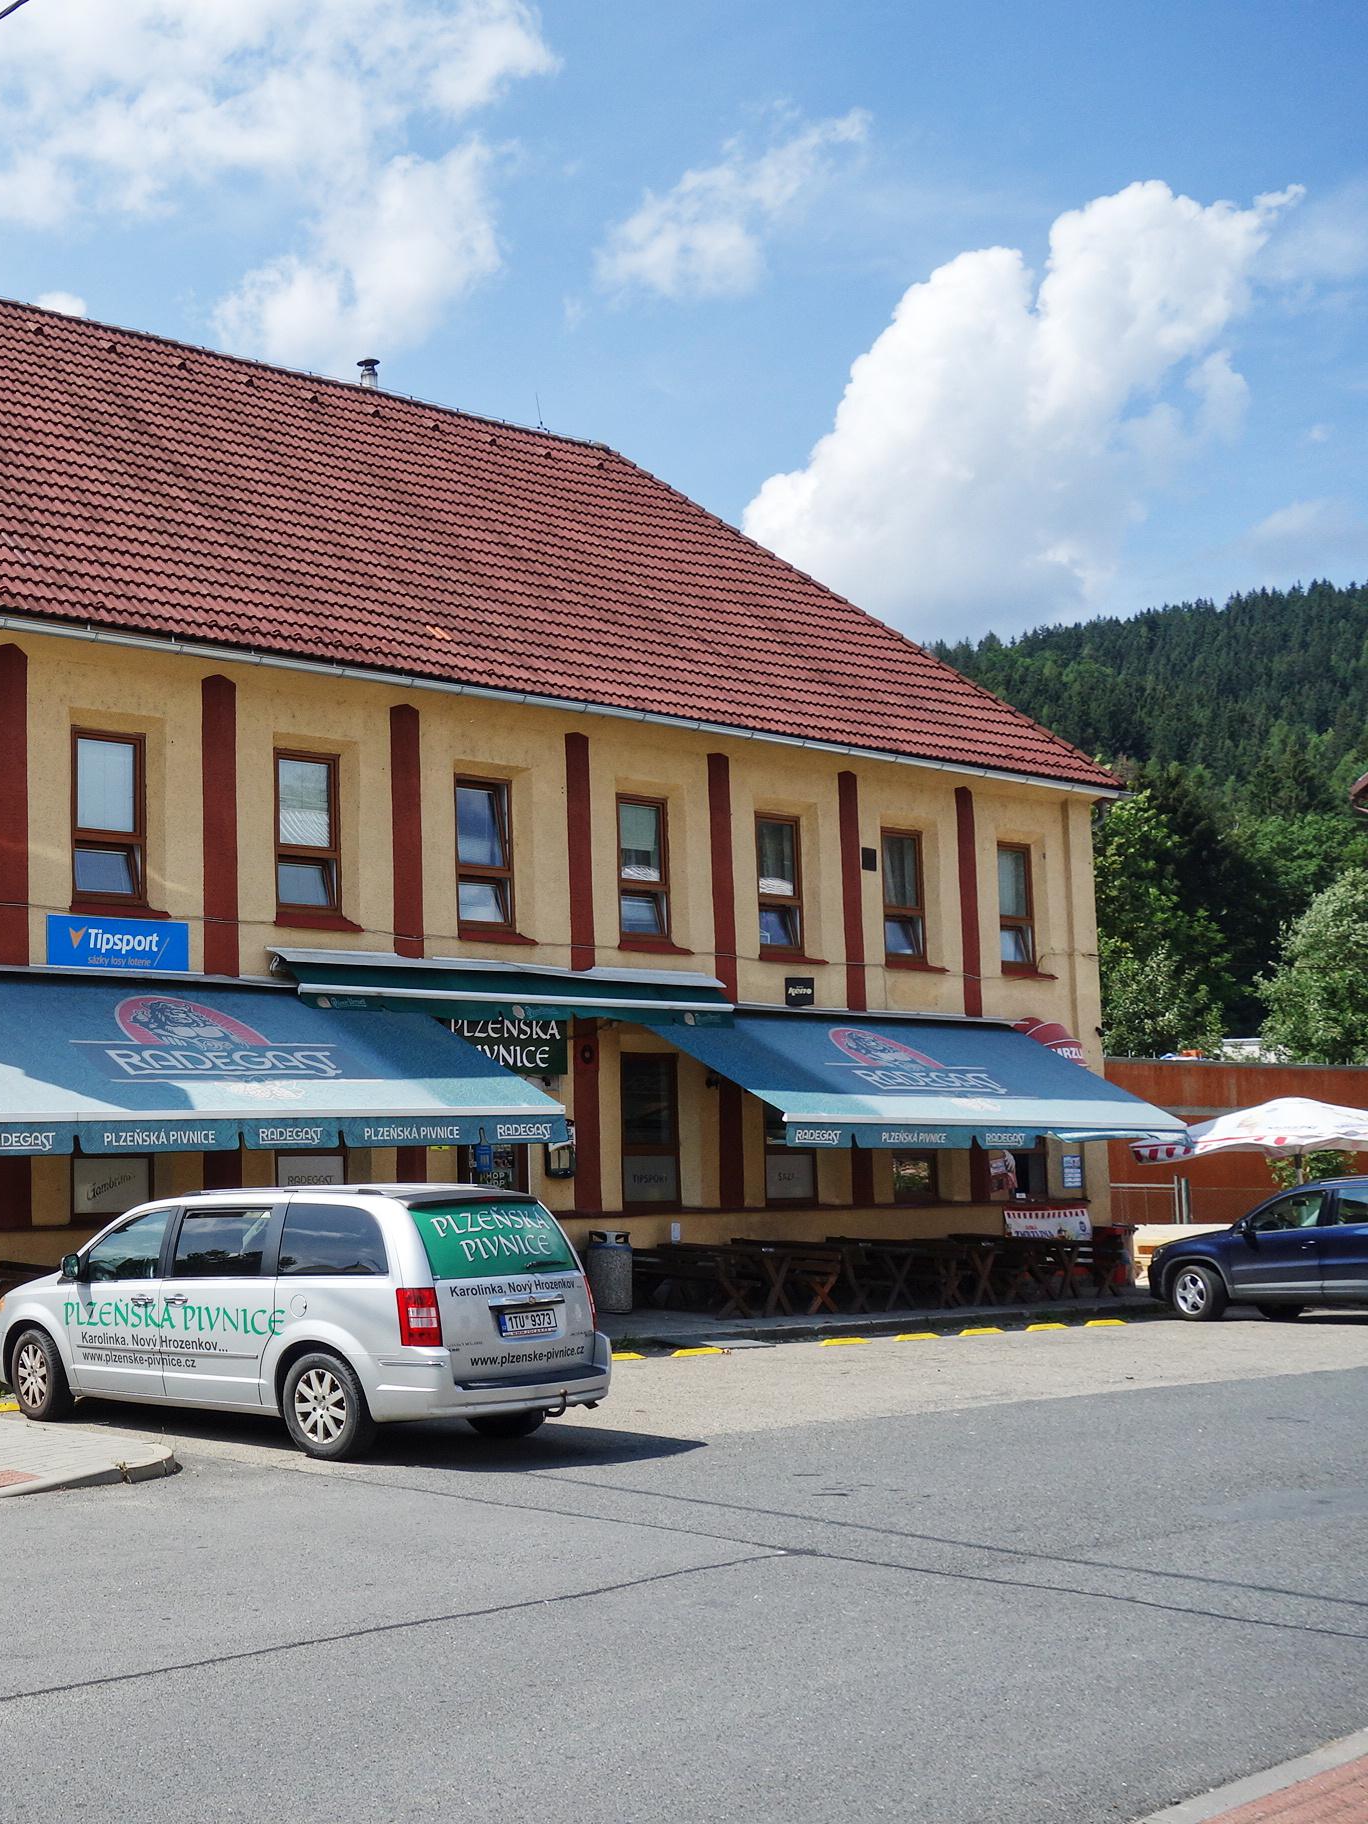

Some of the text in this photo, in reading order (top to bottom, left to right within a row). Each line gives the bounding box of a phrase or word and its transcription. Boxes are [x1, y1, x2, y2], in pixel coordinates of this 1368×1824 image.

[88, 928, 159, 954] Tipsport
[87, 954, 152, 967] sázky losy loterie
[105, 1050, 343, 1077] RADEGAST
[851, 1070, 1008, 1095] RADEGAST
[104, 1128, 216, 1146] PLZEŇSKÁ PIVNICE
[259, 1127, 323, 1145] RADEGAST
[364, 1124, 460, 1140] PLZEŇSKÁ PIVNICE
[497, 1123, 552, 1139] RADEGAST
[795, 1129, 842, 1145] RADEGAST
[881, 1130, 947, 1143] PLZEŇSKÁ PIVNICE
[985, 1132, 1026, 1147] RADEGAST
[287, 1174, 335, 1186] RADEGAST
[459, 1234, 552, 1263] PIVNICE
[449, 1283, 507, 1297] Karolinka,
[508, 1280, 532, 1294] Nový
[182, 1304, 286, 1337] PIVNICE
[508, 1312, 552, 1330] 1TU 9373
[132, 1334, 158, 1350] Nový
[82, 1350, 197, 1368] www.plzenske-pivnice.cz
[470, 1344, 585, 1367] www.plzenske-pivnice.cz
